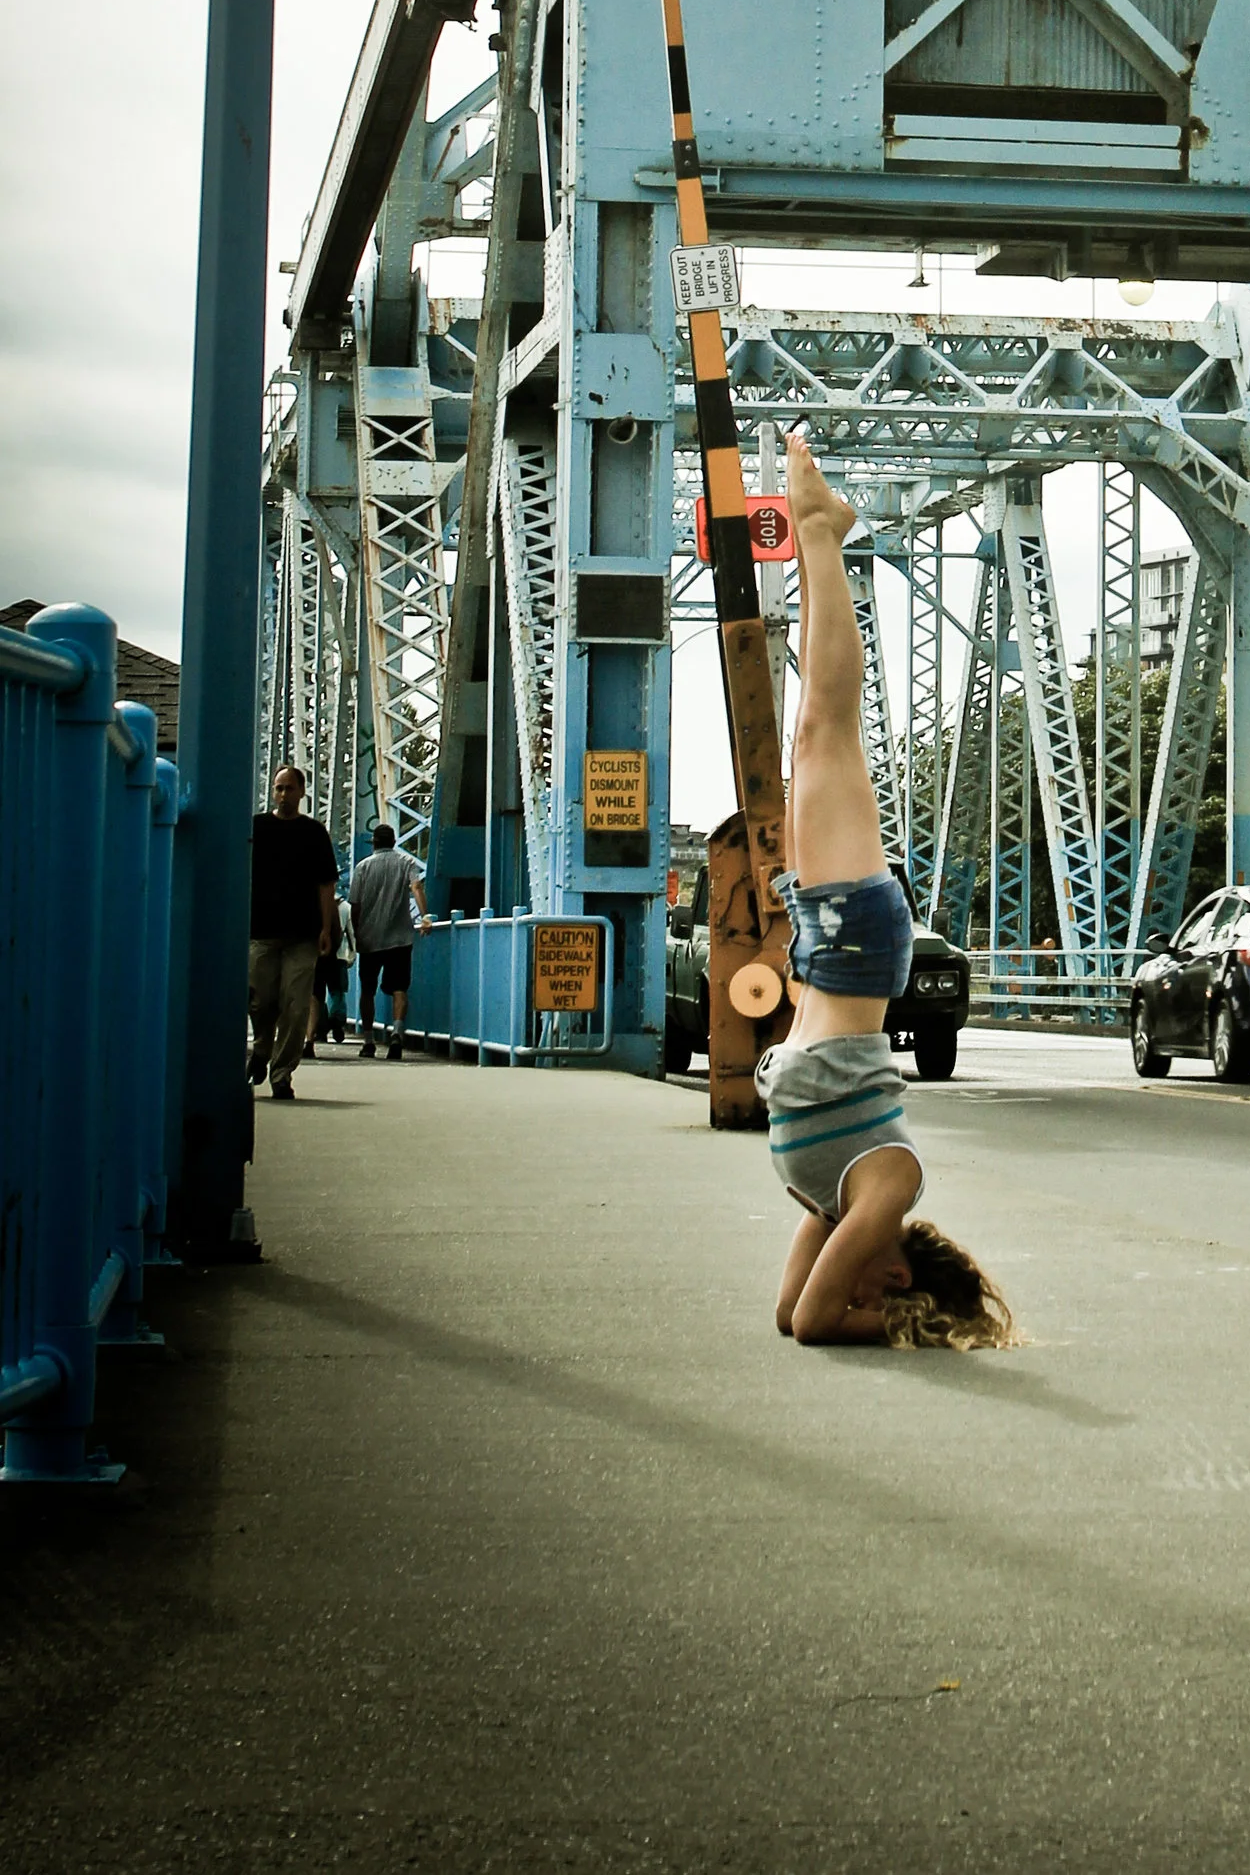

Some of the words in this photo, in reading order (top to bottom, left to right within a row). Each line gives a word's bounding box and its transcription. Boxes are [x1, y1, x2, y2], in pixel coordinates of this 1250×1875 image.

[677, 256, 688, 276] OUT
[706, 260, 715, 270] IN
[692, 260, 705, 297] BRIDGE
[718, 248, 734, 303] PROGRESS
[707, 274, 719, 294] LIFT
[680, 279, 692, 305] KEEP
[760, 509, 777, 547] STOP
[589, 760, 641, 773] CYCLISTS
[590, 778, 640, 791] DISMOUNT
[595, 796, 636, 808] WHILE
[589, 812, 604, 825] ON
[607, 813, 640, 826] BRIDGE
[539, 930, 594, 945] CAUTION
[538, 950, 594, 962] SIDEWALK
[540, 965, 591, 977] SLIPPERY
[549, 980, 583, 992] WHEN
[552, 995, 577, 1006] WET
